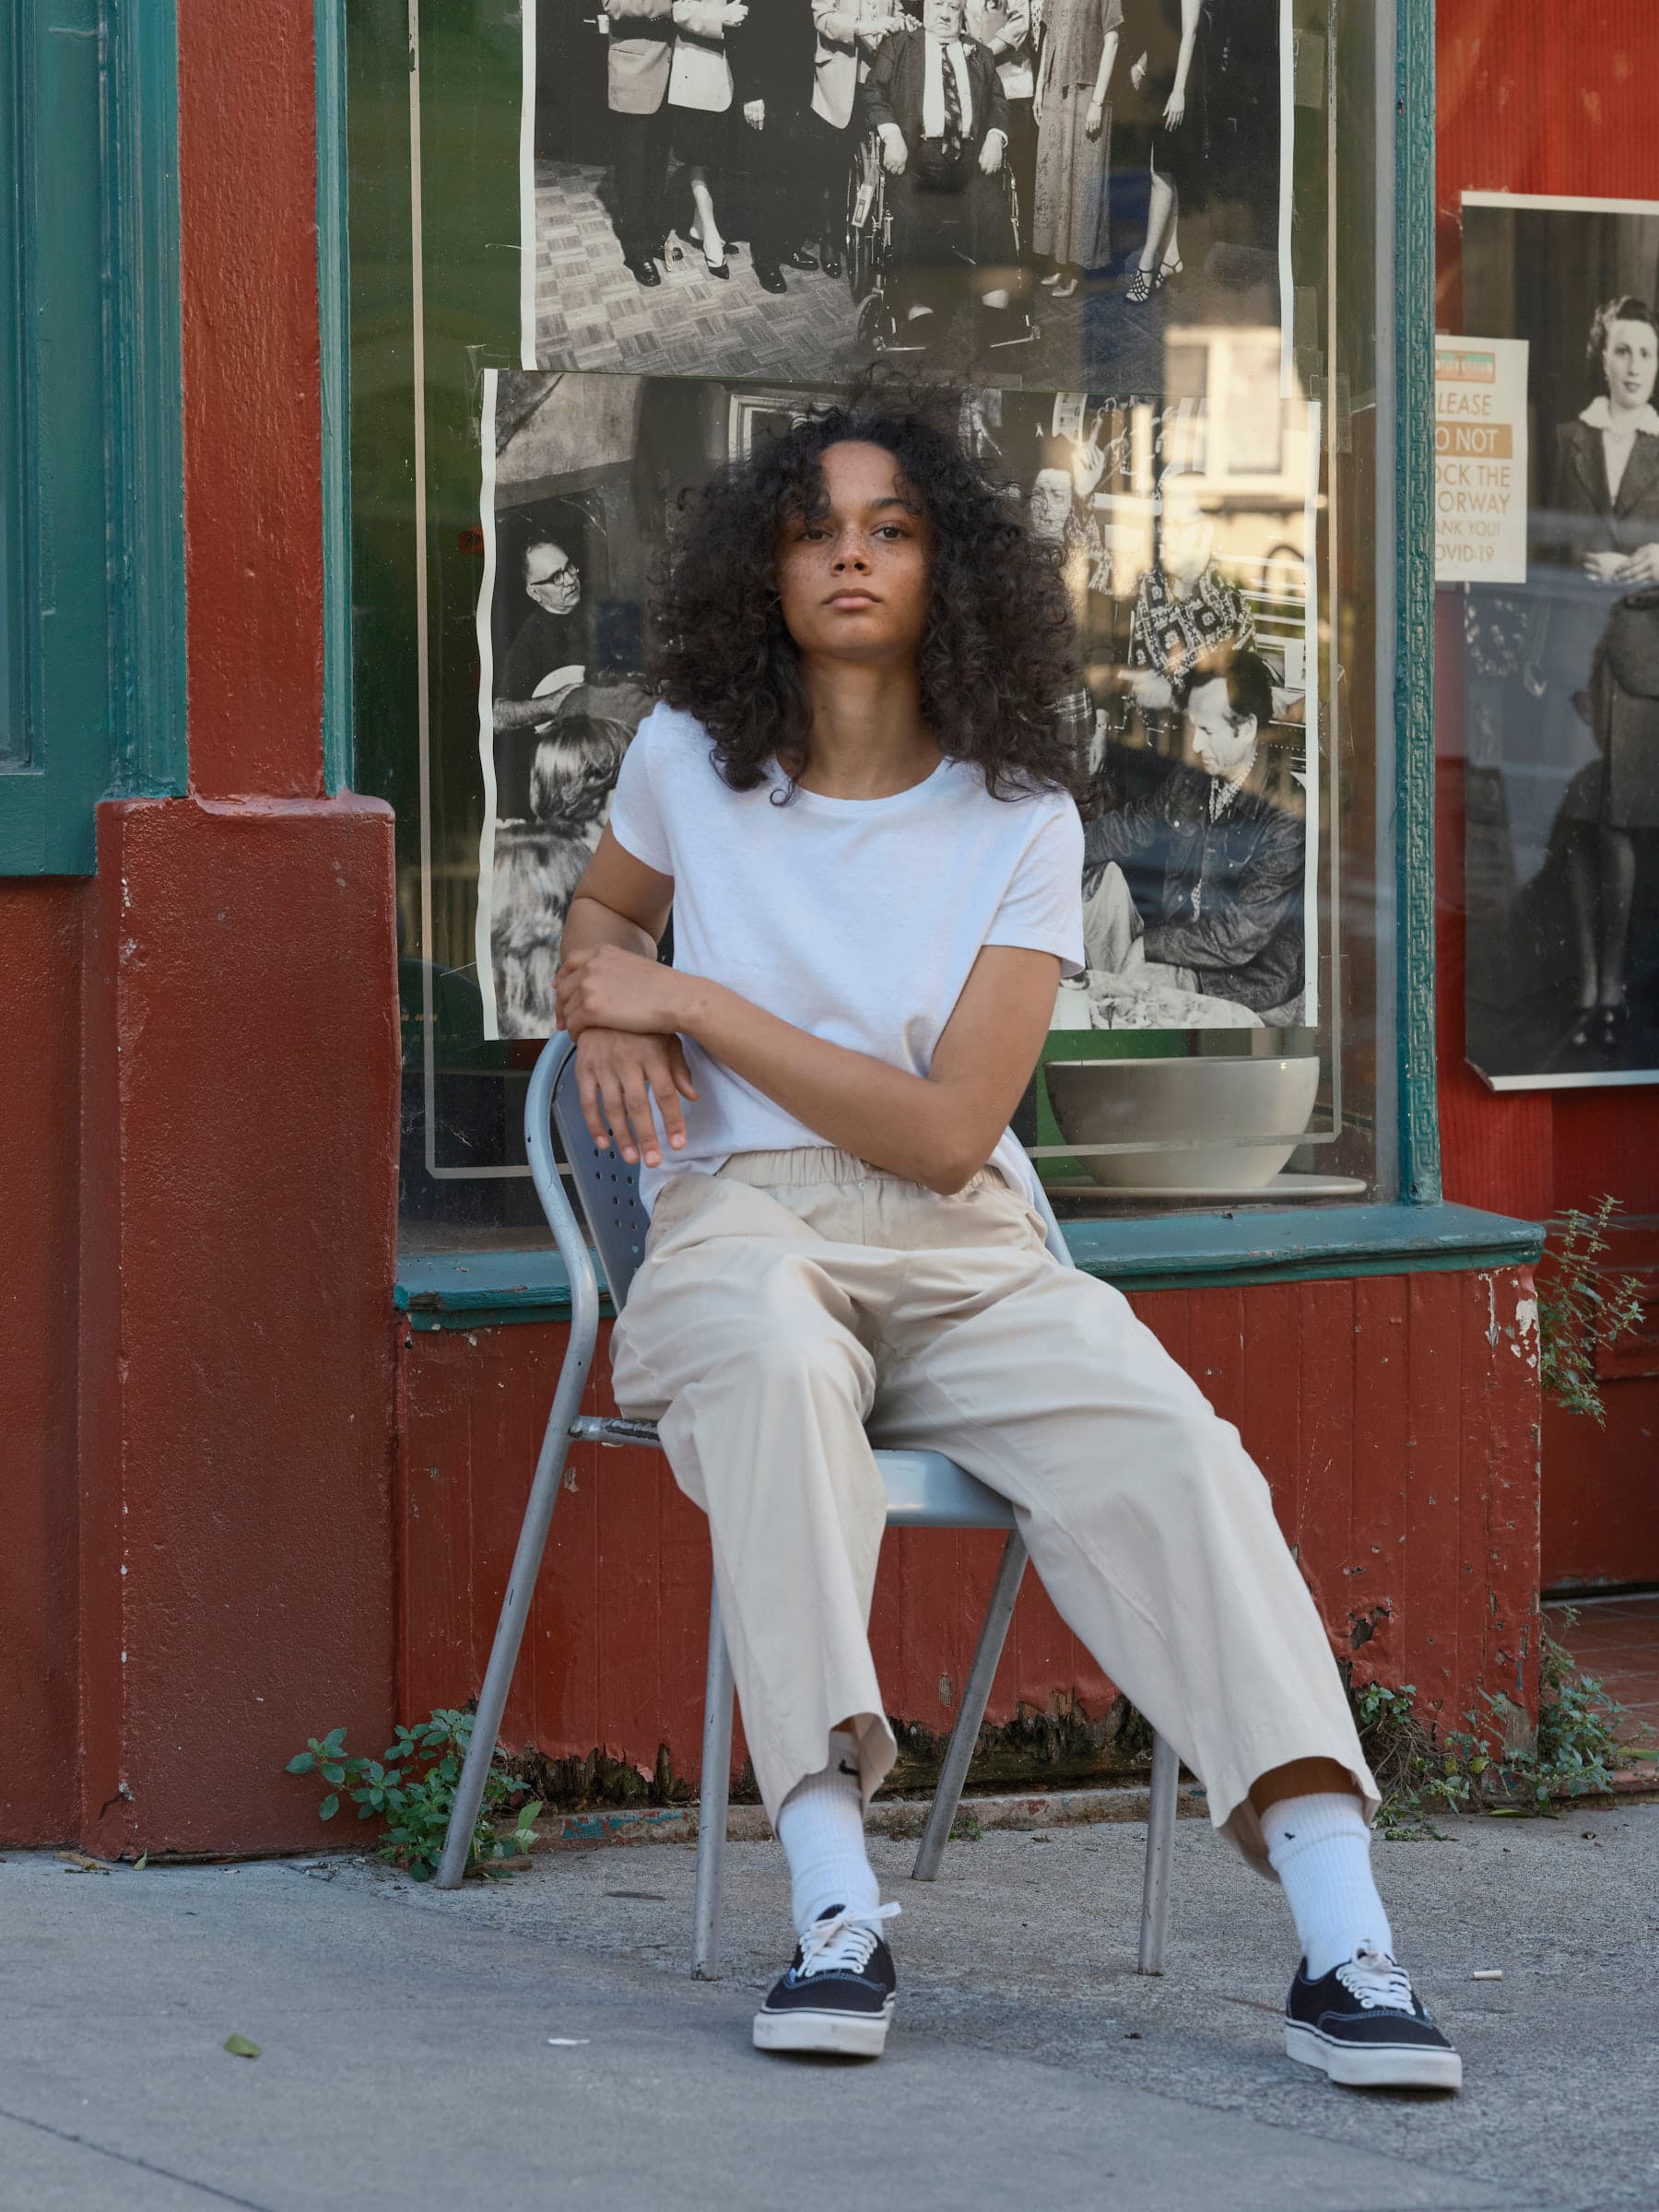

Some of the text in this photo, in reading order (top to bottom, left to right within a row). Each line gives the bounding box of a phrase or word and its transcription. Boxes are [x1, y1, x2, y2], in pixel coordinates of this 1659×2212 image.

[1437, 391, 1492, 417] LEASE
[1435, 426, 1498, 453] O NOT
[1477, 465, 1511, 488] THE
[1438, 490, 1511, 516] ORWAY
[1435, 544, 1495, 562] OVID-19
